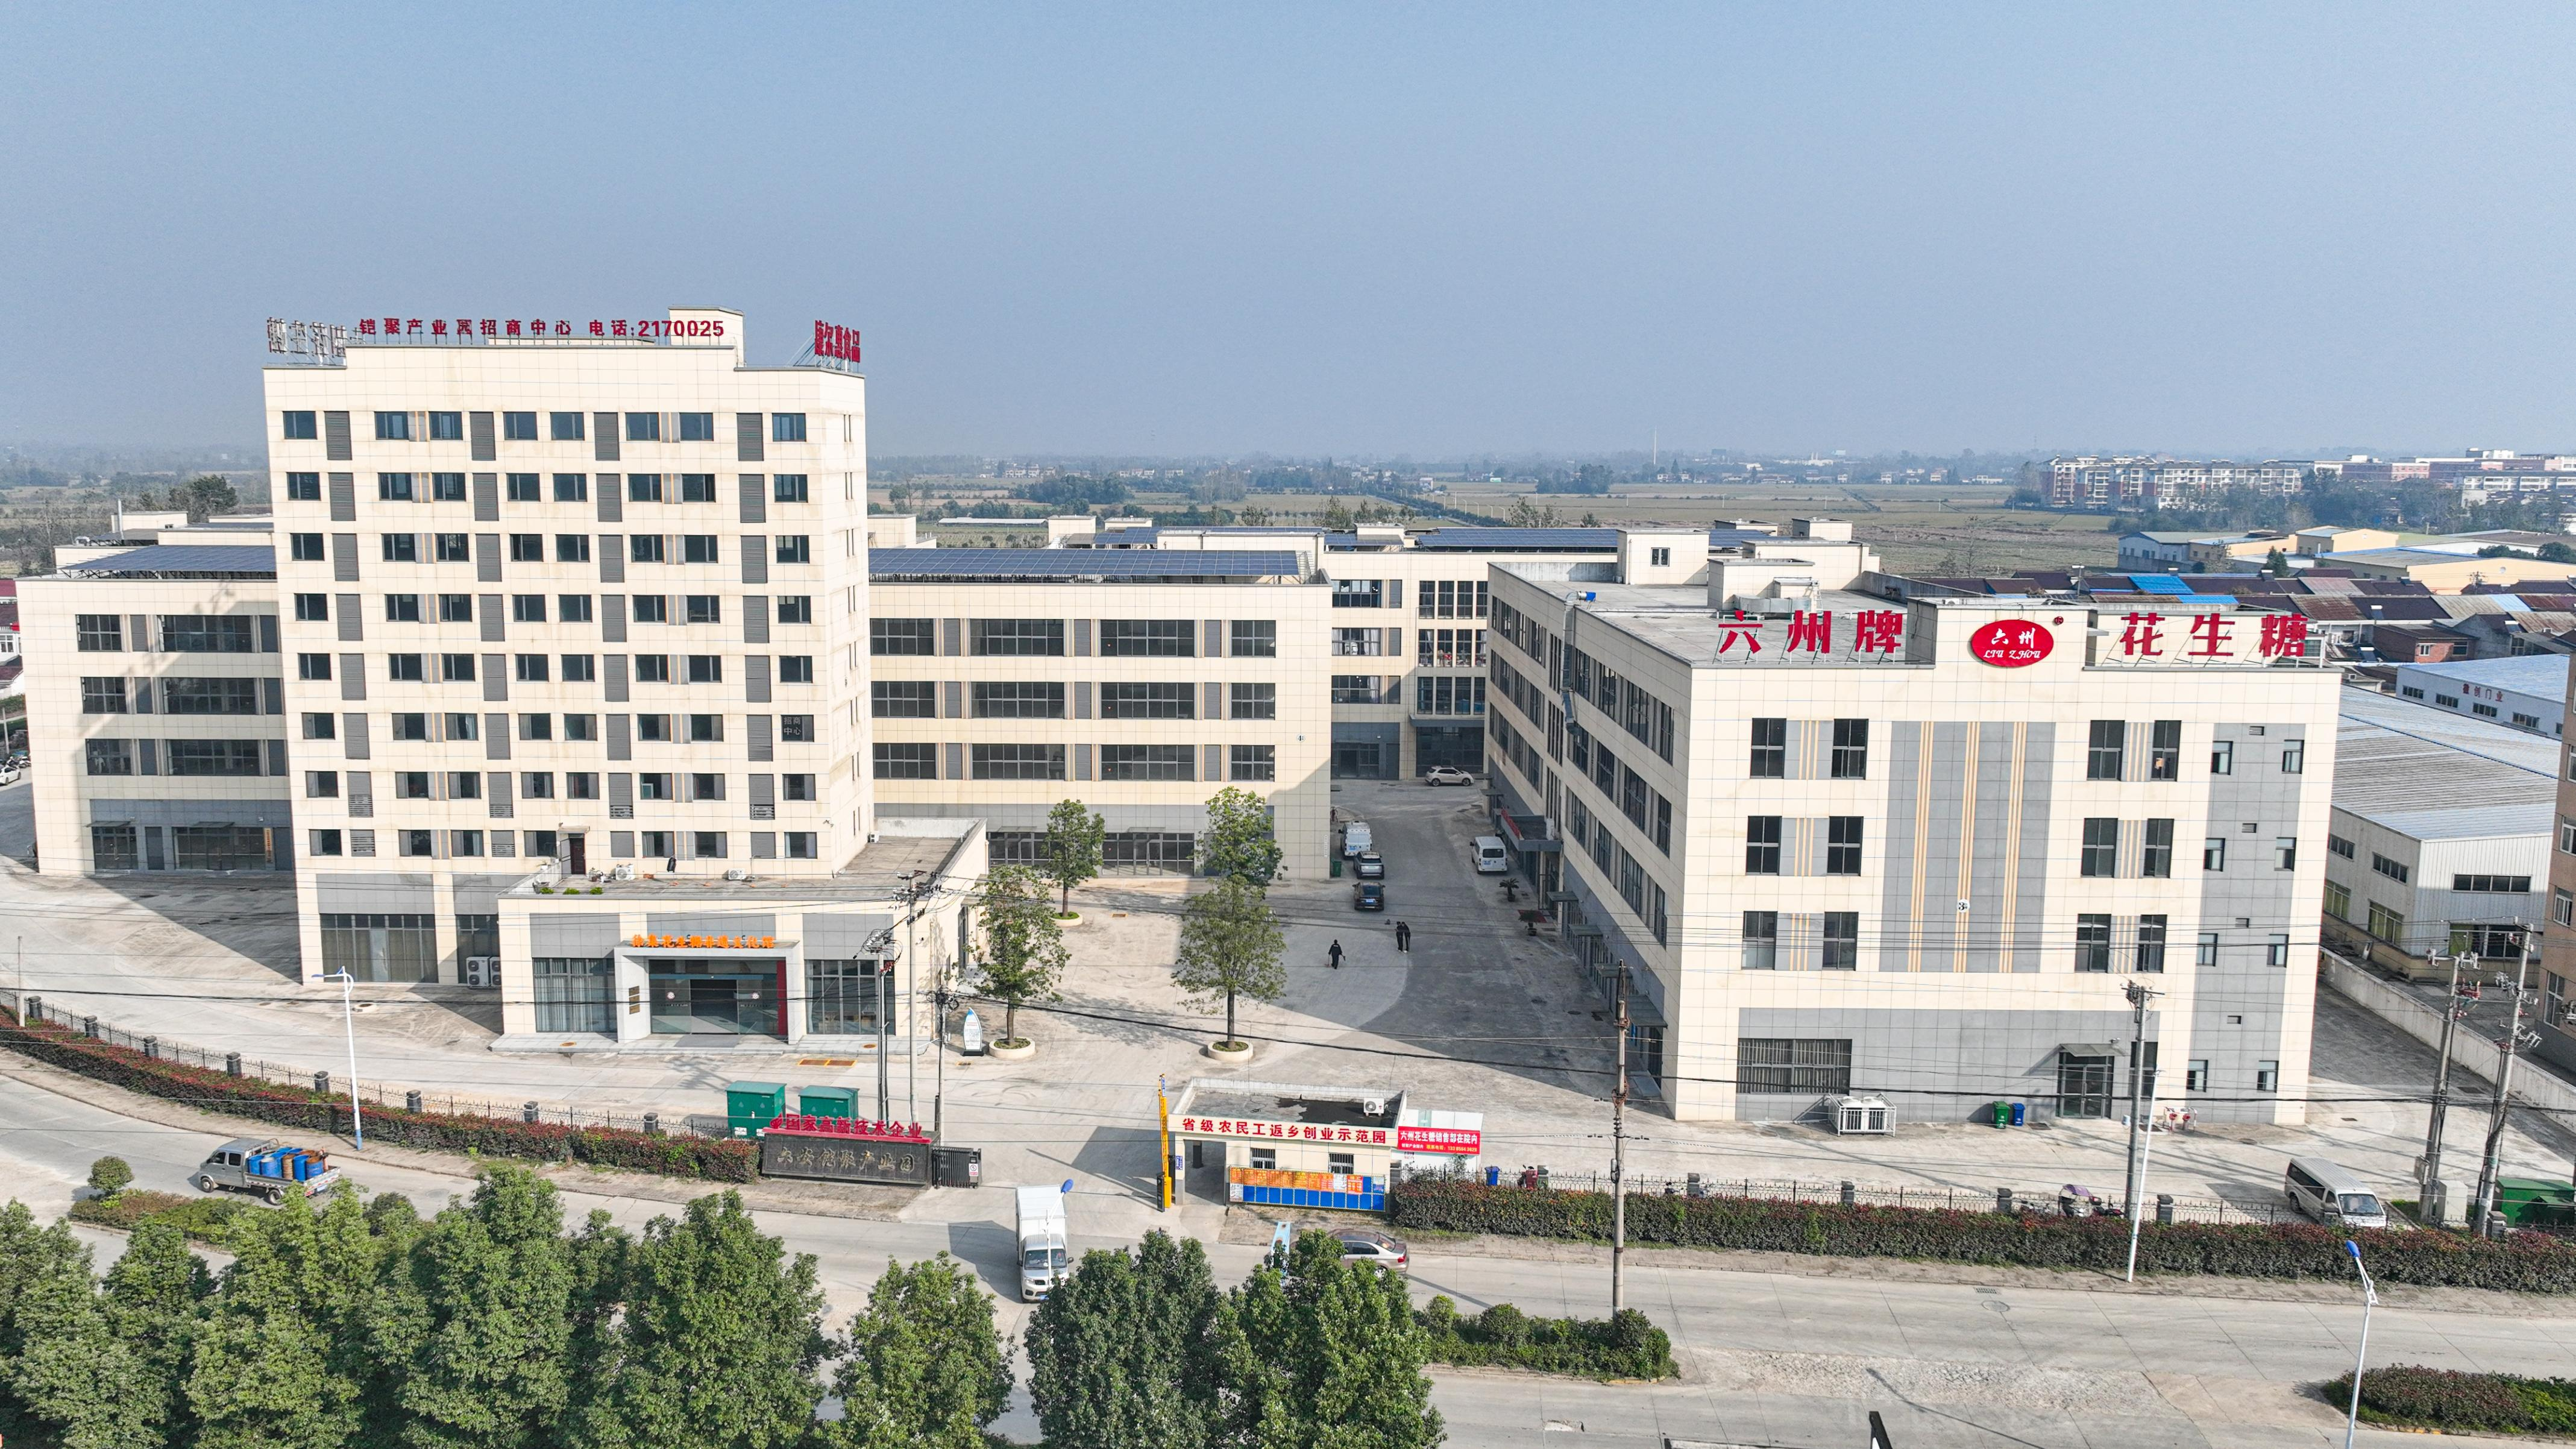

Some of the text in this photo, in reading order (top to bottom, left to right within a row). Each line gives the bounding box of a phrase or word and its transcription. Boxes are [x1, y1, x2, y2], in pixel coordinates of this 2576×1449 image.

[359, 318, 571, 335] 铠聚产业园招商中心
[1718, 610, 2308, 656] 六州牌 花生糖
[1991, 627, 2035, 649] 六州
[1984, 649, 2041, 659] LIU ZHOU
[784, 727, 801, 735] 中心
[785, 1113, 922, 1139] 国家高新技术企业
[1182, 1118, 1386, 1144] 省级农民工返乡创业示范园
[1400, 1131, 1478, 1144] 六州花生糖销售部在院内
